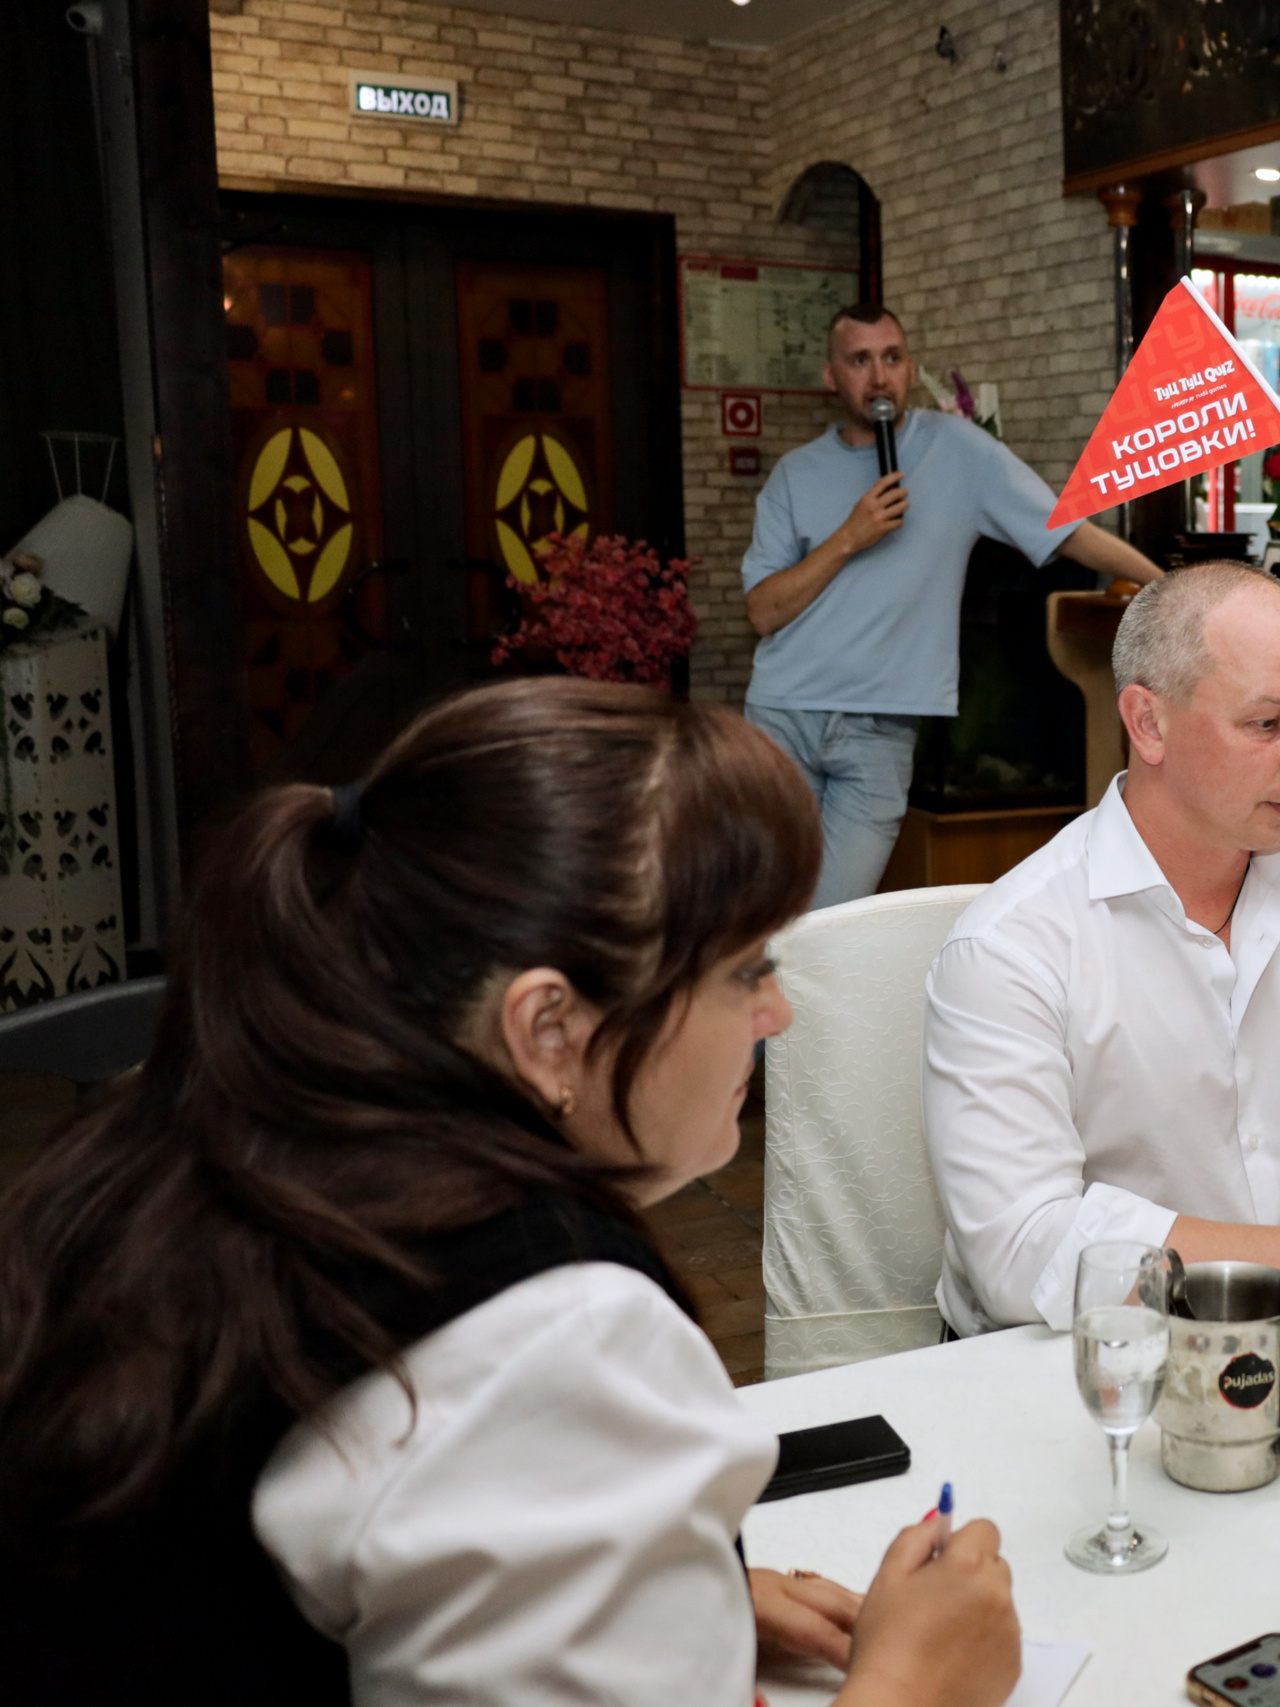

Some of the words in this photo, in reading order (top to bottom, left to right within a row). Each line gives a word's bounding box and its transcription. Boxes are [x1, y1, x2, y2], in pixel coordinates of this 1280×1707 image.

[359, 86, 449, 119] ВЫХОД
[1111, 391, 1248, 460] КОРОЛИ
[1090, 418, 1257, 495] ТУЦОВКИ!
[1223, 1371, 1275, 1390] pujadas
